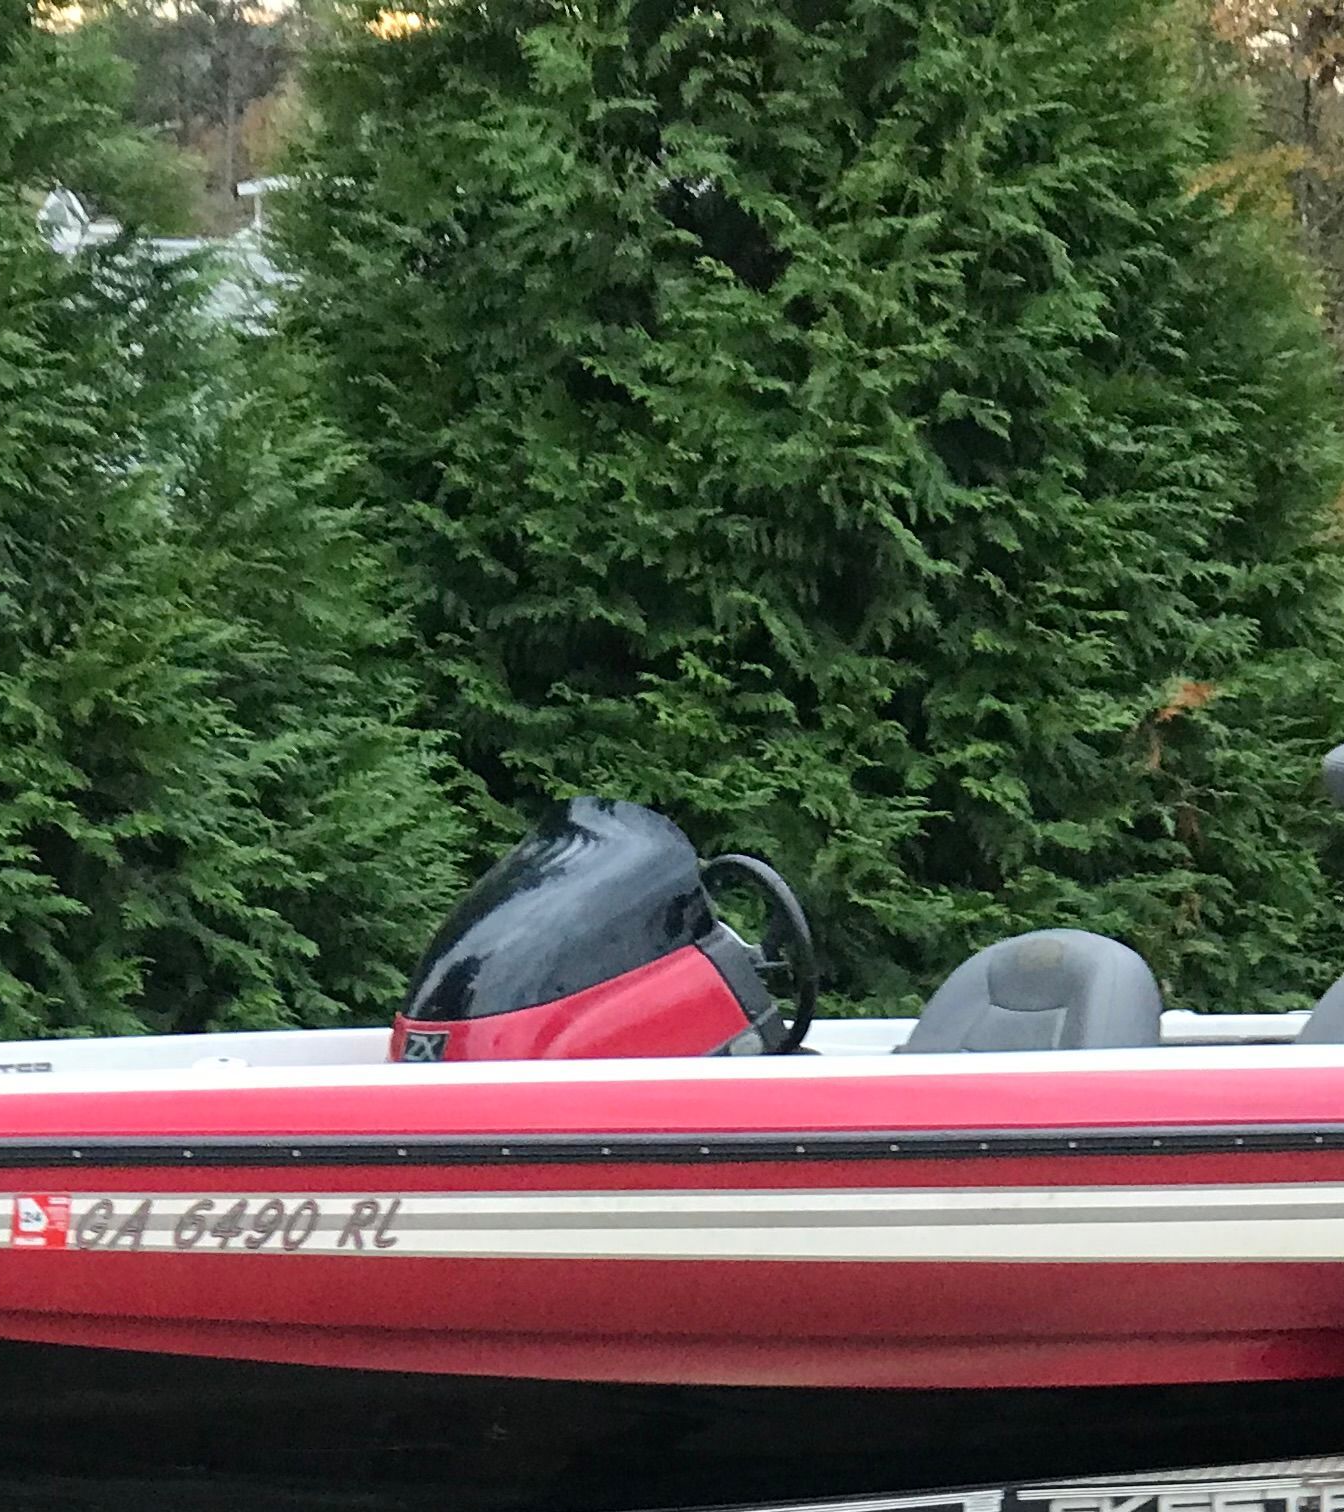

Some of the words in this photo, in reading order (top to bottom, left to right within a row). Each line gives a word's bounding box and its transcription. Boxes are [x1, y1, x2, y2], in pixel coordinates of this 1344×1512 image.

[76, 1198, 154, 1251] GA
[174, 1198, 321, 1252] 6490
[338, 1198, 402, 1250] RL
